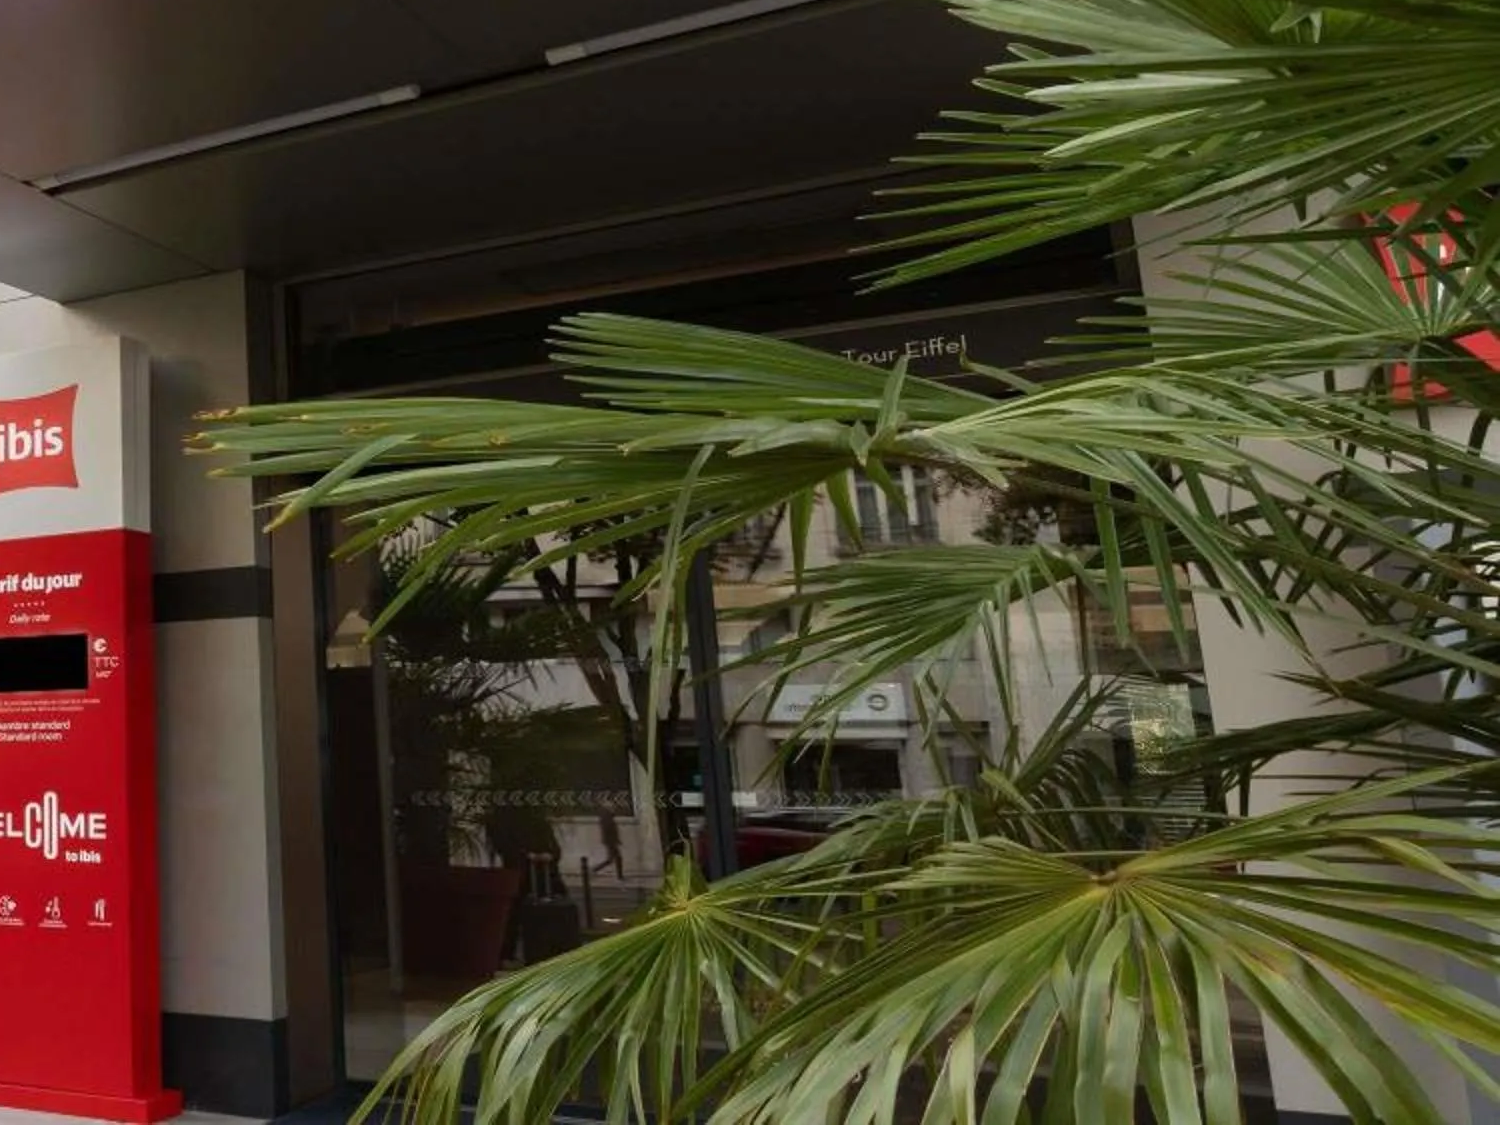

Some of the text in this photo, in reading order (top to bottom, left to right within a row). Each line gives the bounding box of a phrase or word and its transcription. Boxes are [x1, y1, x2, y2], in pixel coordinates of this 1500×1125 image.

[841, 334, 966, 364] Tour Eiffel
[21, 572, 45, 591] du
[45, 572, 82, 594] jour
[8, 613, 30, 624] Daily
[31, 719, 71, 731] standard
[38, 732, 63, 742] room
[65, 850, 102, 864] to ibis
